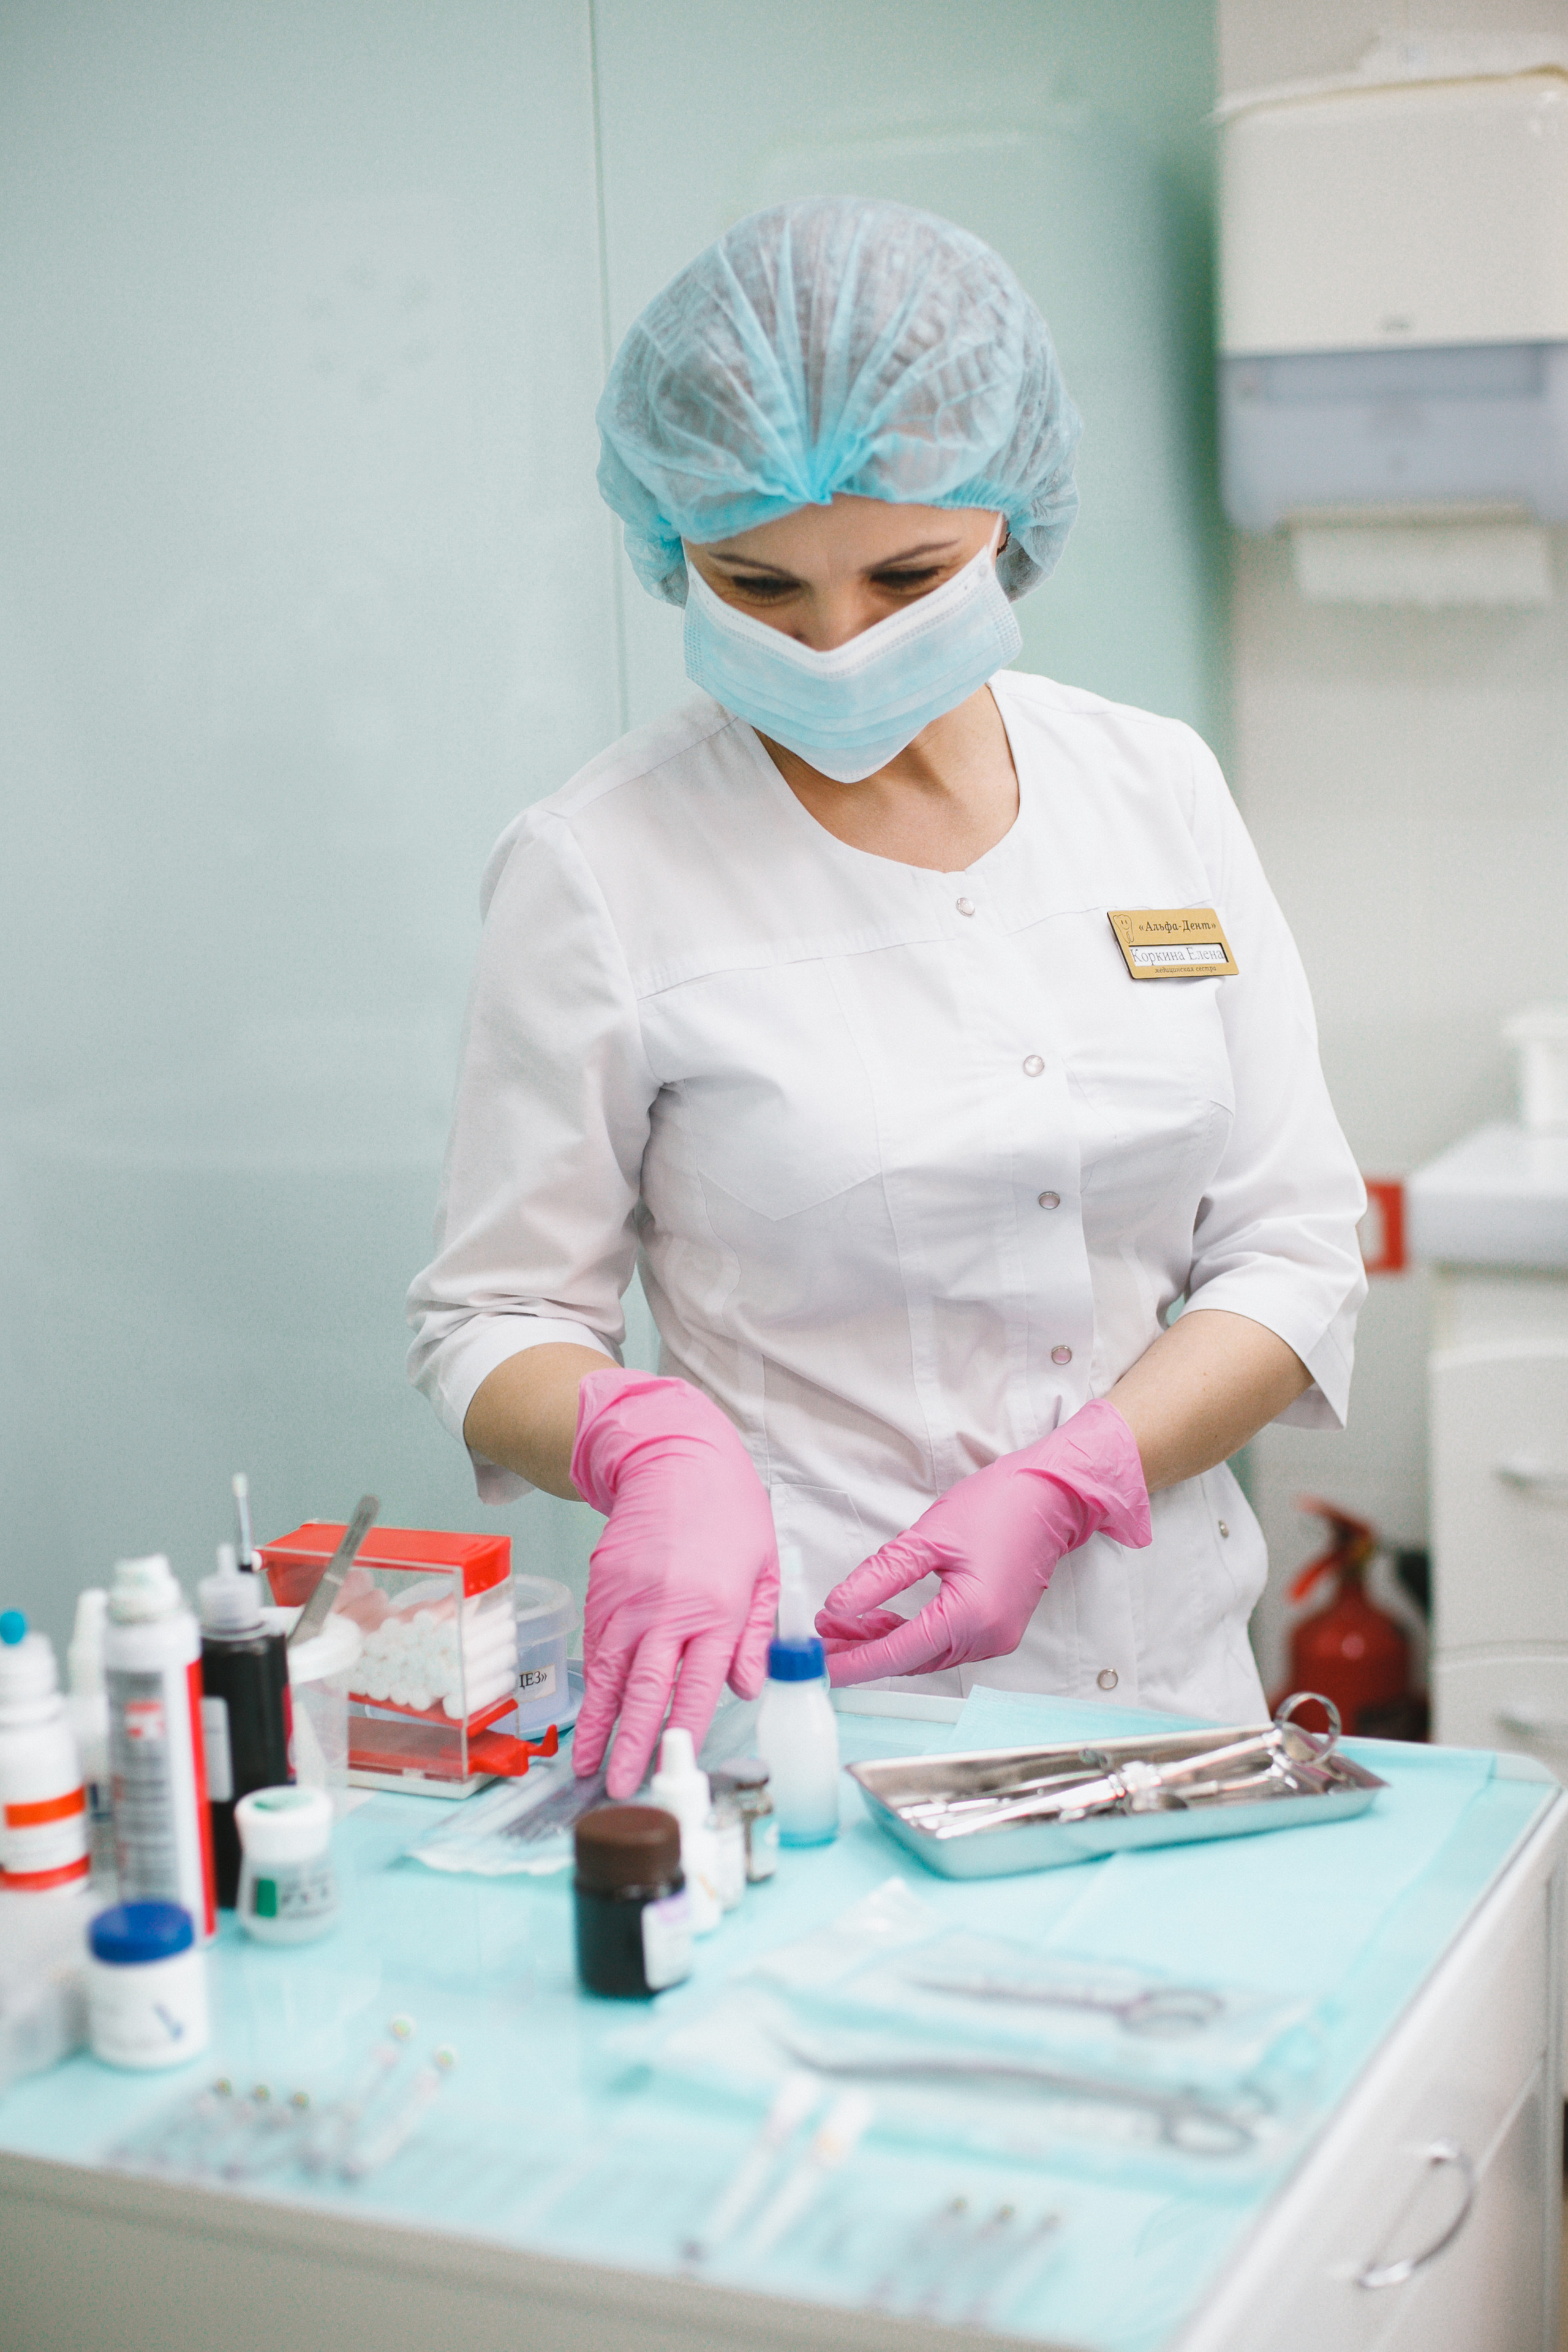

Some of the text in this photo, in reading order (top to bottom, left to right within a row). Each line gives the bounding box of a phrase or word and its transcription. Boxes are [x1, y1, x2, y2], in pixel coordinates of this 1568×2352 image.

[1139, 920, 1216, 933] «Альфа-Дент»
[1130, 947, 1225, 966] Коркина Елена
